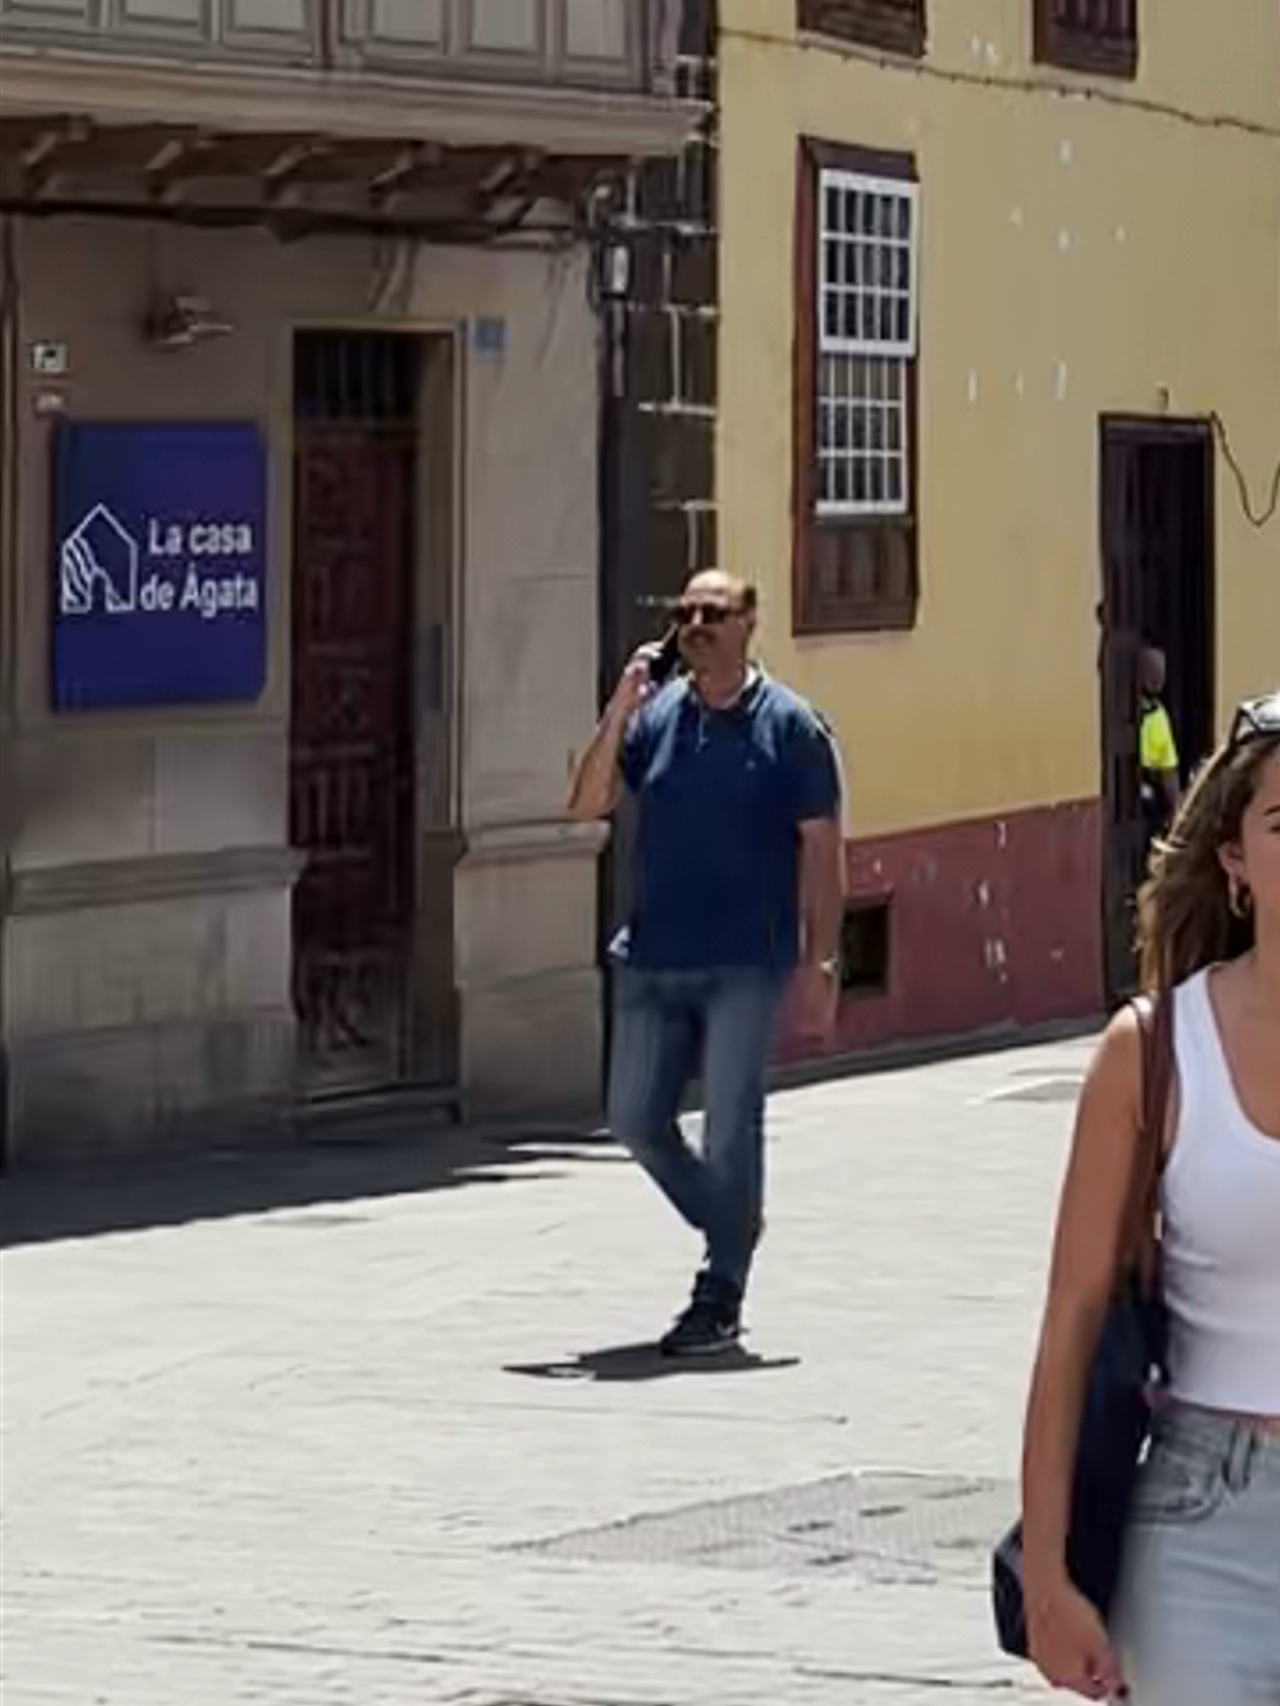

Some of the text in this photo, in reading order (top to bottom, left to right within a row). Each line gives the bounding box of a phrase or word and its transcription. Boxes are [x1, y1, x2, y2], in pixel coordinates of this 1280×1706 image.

[150, 517, 251, 555] La casa
[140, 560, 258, 618] de Ágata
